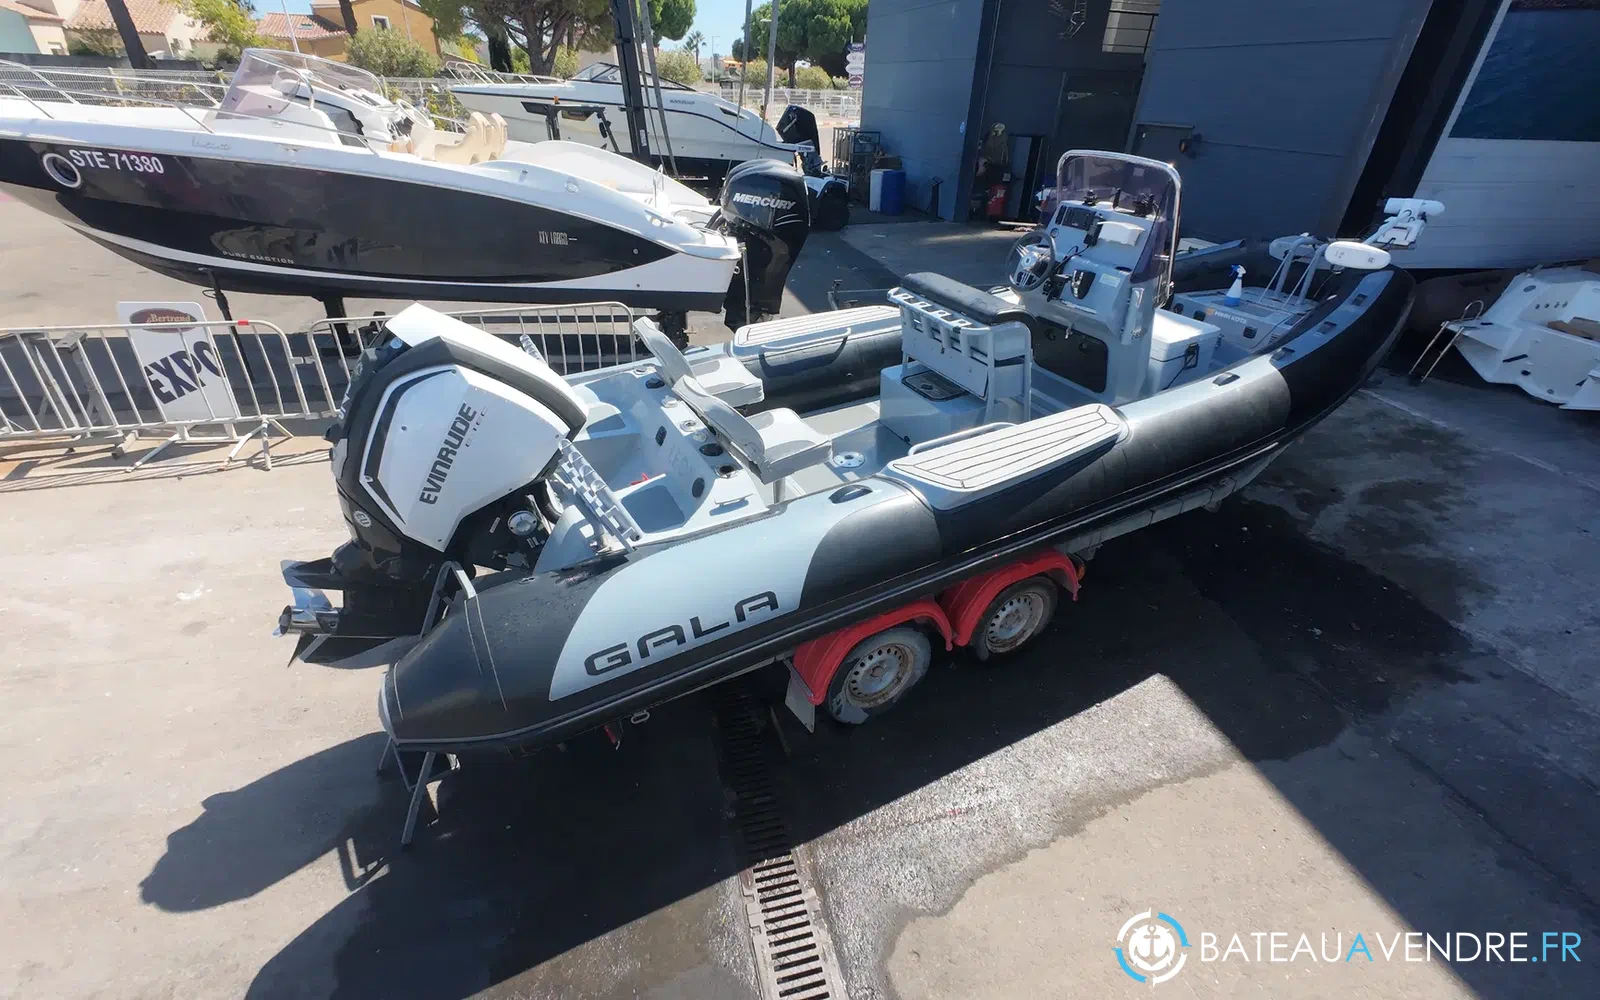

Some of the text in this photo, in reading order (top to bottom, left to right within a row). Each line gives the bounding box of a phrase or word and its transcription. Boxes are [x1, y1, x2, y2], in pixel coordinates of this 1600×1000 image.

[68, 149, 164, 174] STE 71380
[732, 192, 797, 210] MERCURY
[249, 254, 295, 265] EMOTION
[143, 340, 226, 405] EXPO
[418, 402, 478, 505] EVINRUDE
[583, 590, 779, 676] GALA
